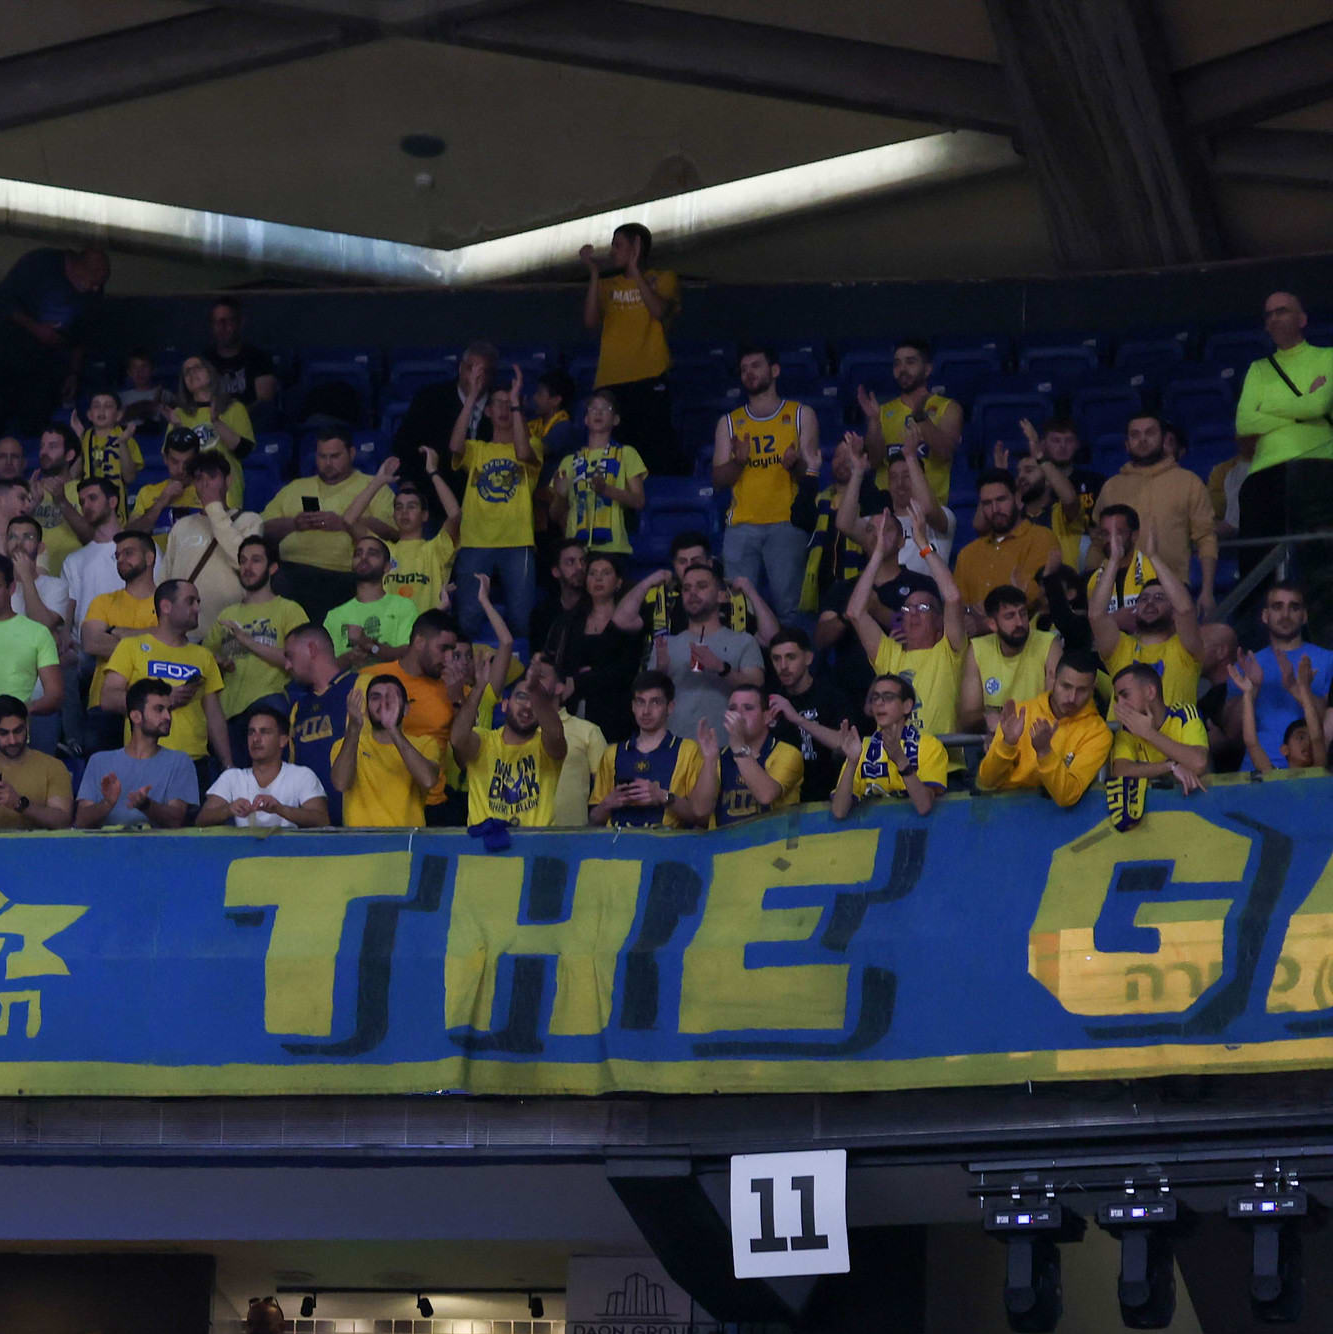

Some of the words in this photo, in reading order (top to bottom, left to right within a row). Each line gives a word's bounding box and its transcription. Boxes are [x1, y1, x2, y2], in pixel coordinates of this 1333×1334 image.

[749, 435, 774, 454] 12
[153, 663, 197, 678] FOX
[224, 828, 882, 1040] THE
[749, 1175, 829, 1253] 11
